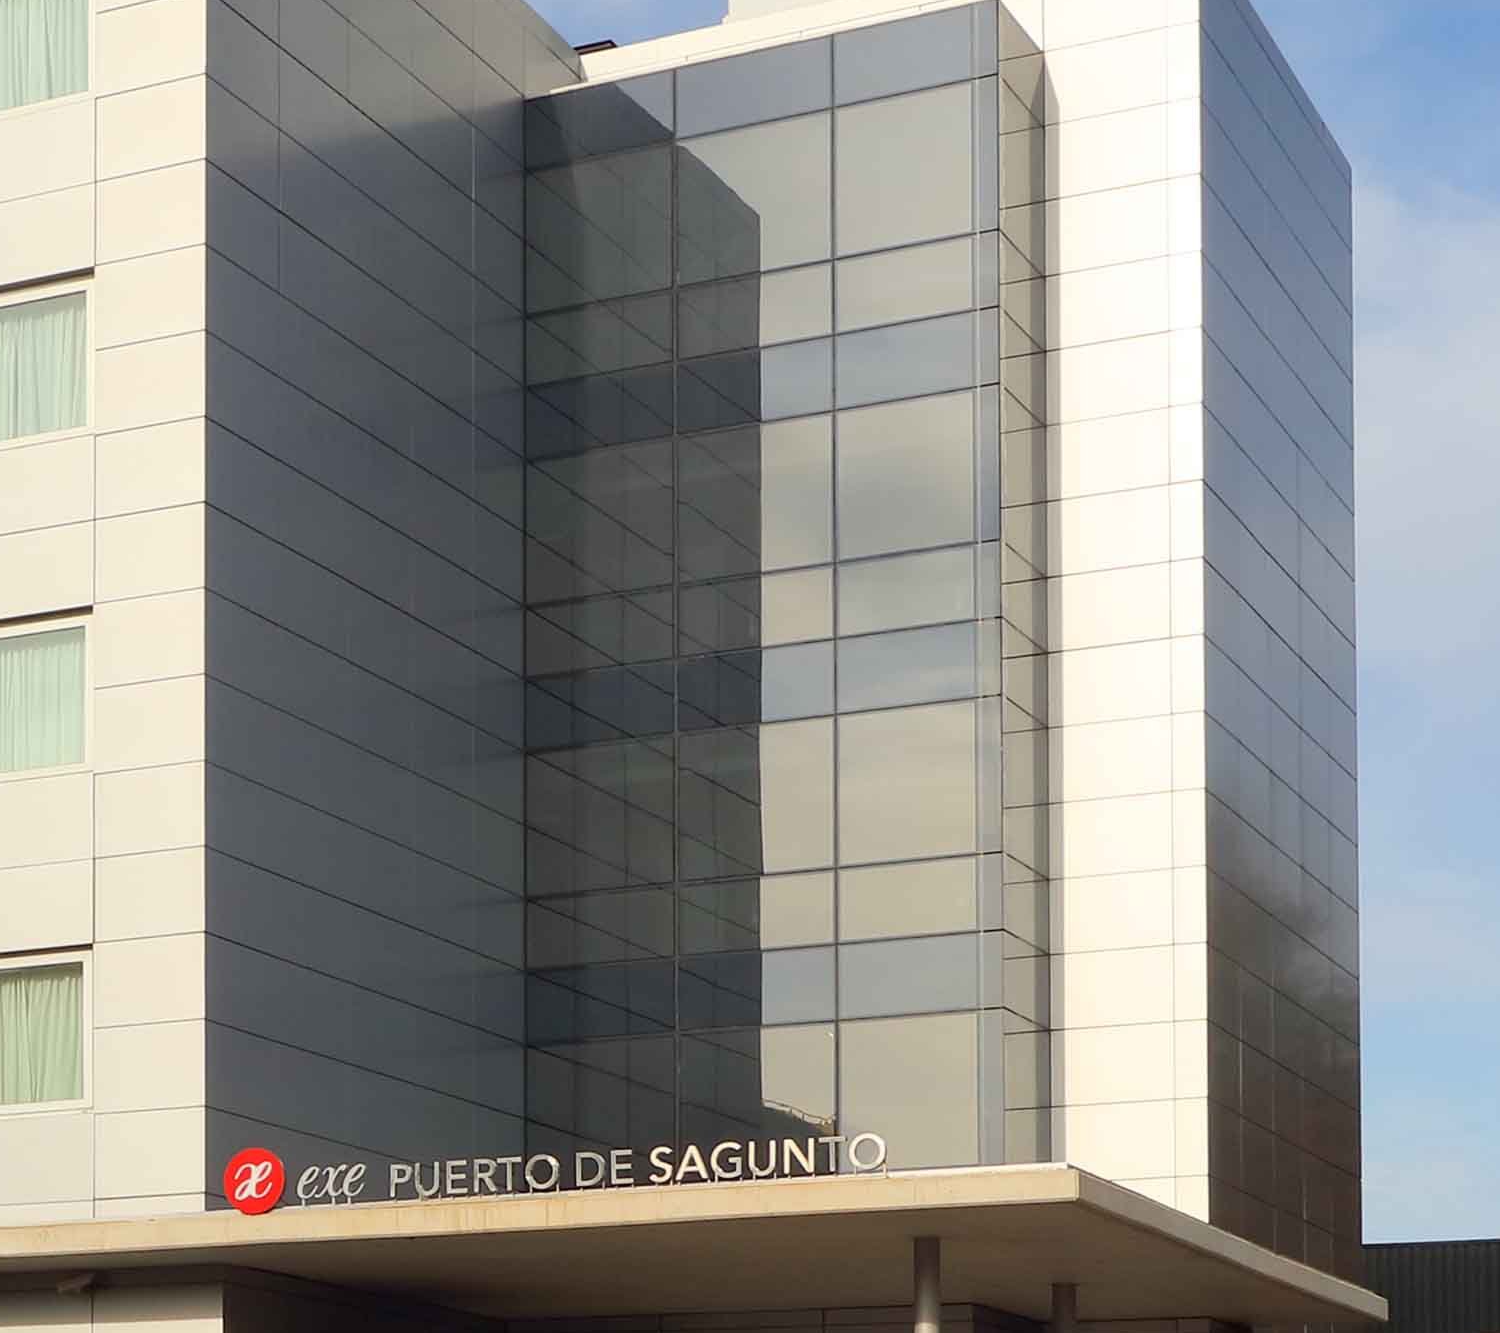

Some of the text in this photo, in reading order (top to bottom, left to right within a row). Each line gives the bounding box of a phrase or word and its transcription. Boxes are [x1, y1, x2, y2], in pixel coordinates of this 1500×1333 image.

[296, 1163, 367, 1199] exe
[389, 1153, 561, 1198] PUERTO
[574, 1148, 635, 1188] DE
[649, 1132, 887, 1184] SAGUNTO
